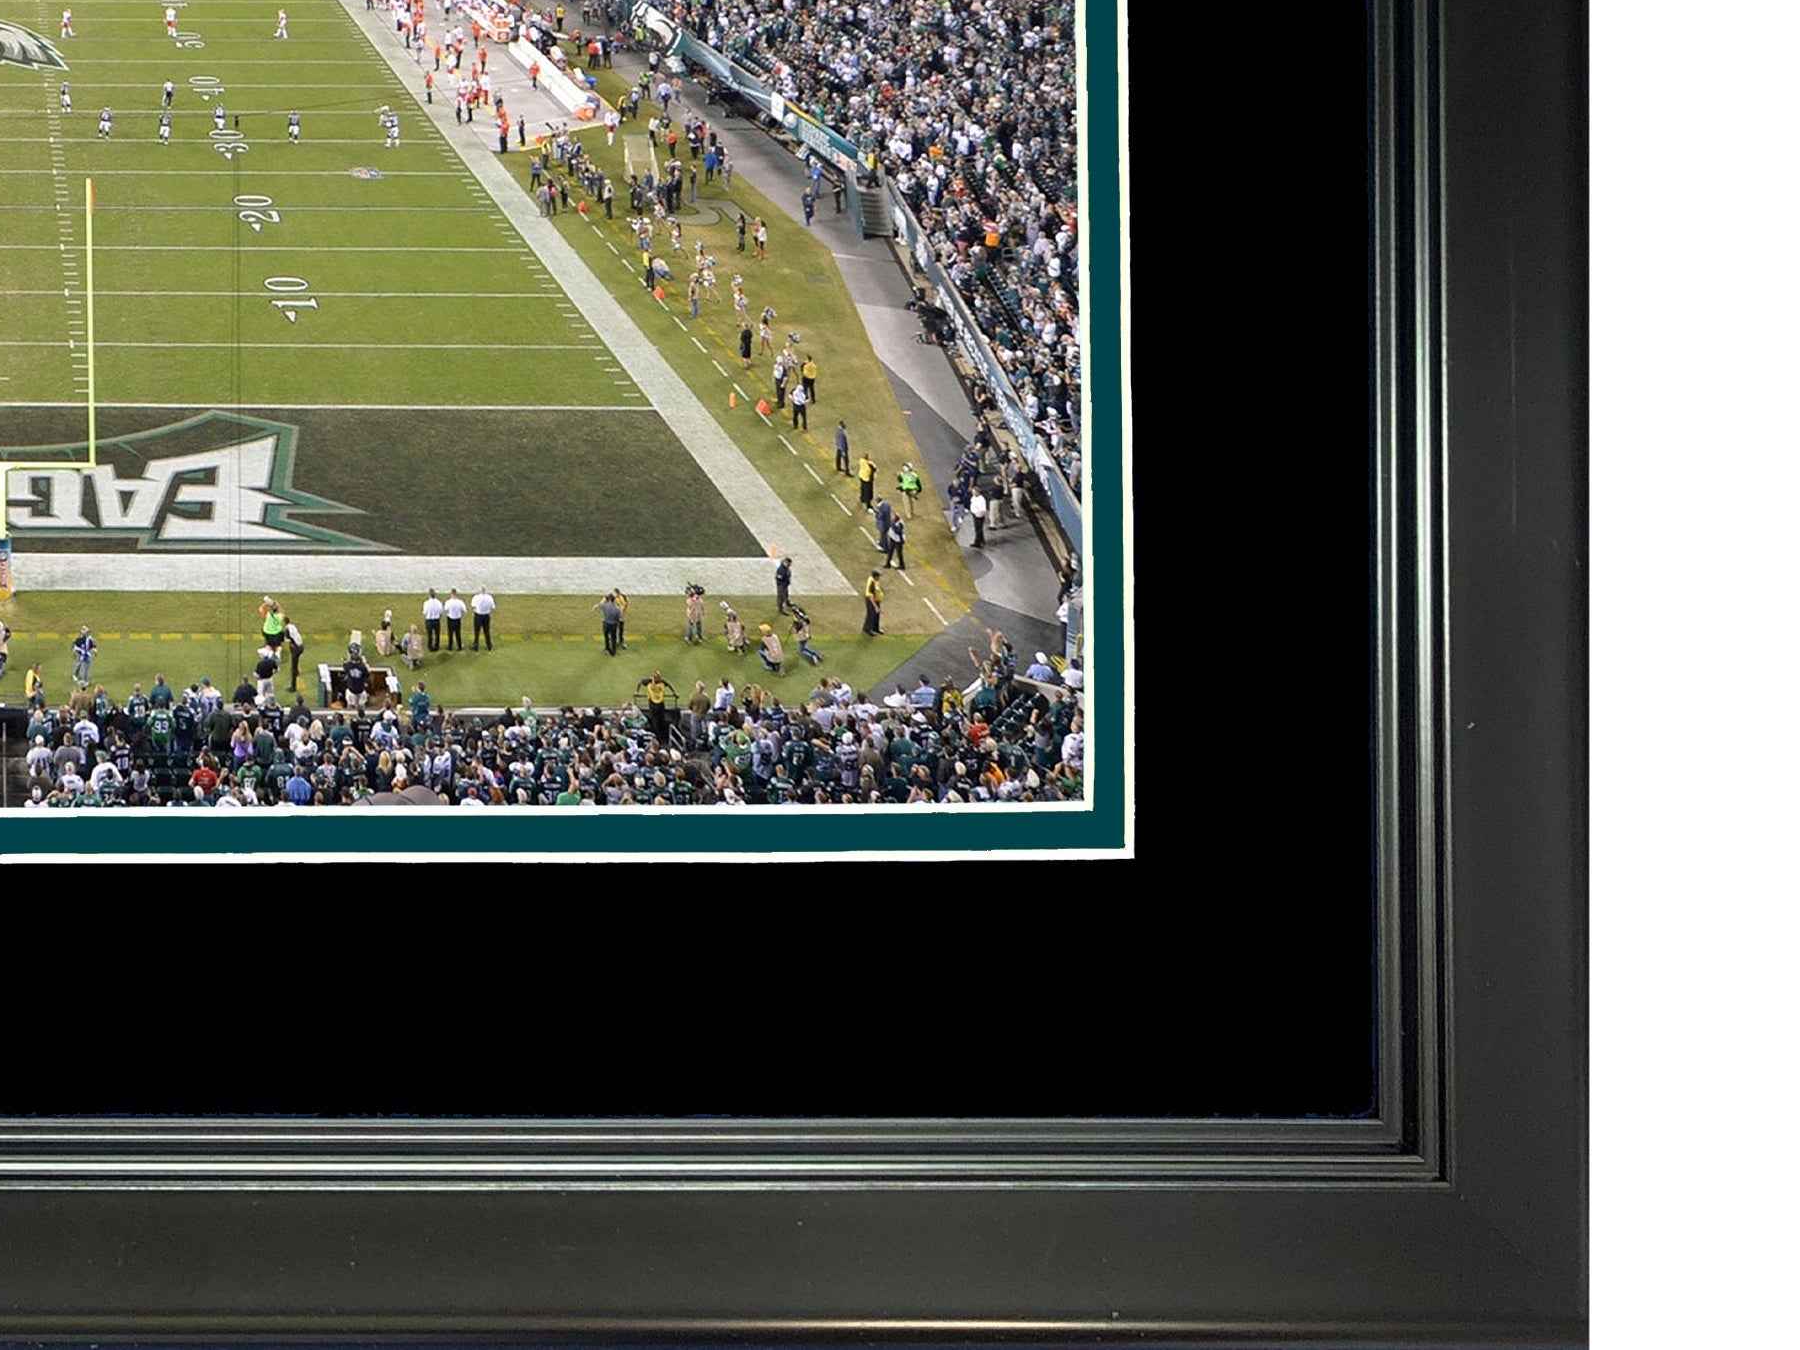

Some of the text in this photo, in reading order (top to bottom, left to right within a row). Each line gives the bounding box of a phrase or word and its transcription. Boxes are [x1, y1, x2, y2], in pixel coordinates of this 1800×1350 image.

[208, 129, 249, 153] 30
[232, 194, 281, 224] 20
[263, 276, 319, 312] 10
